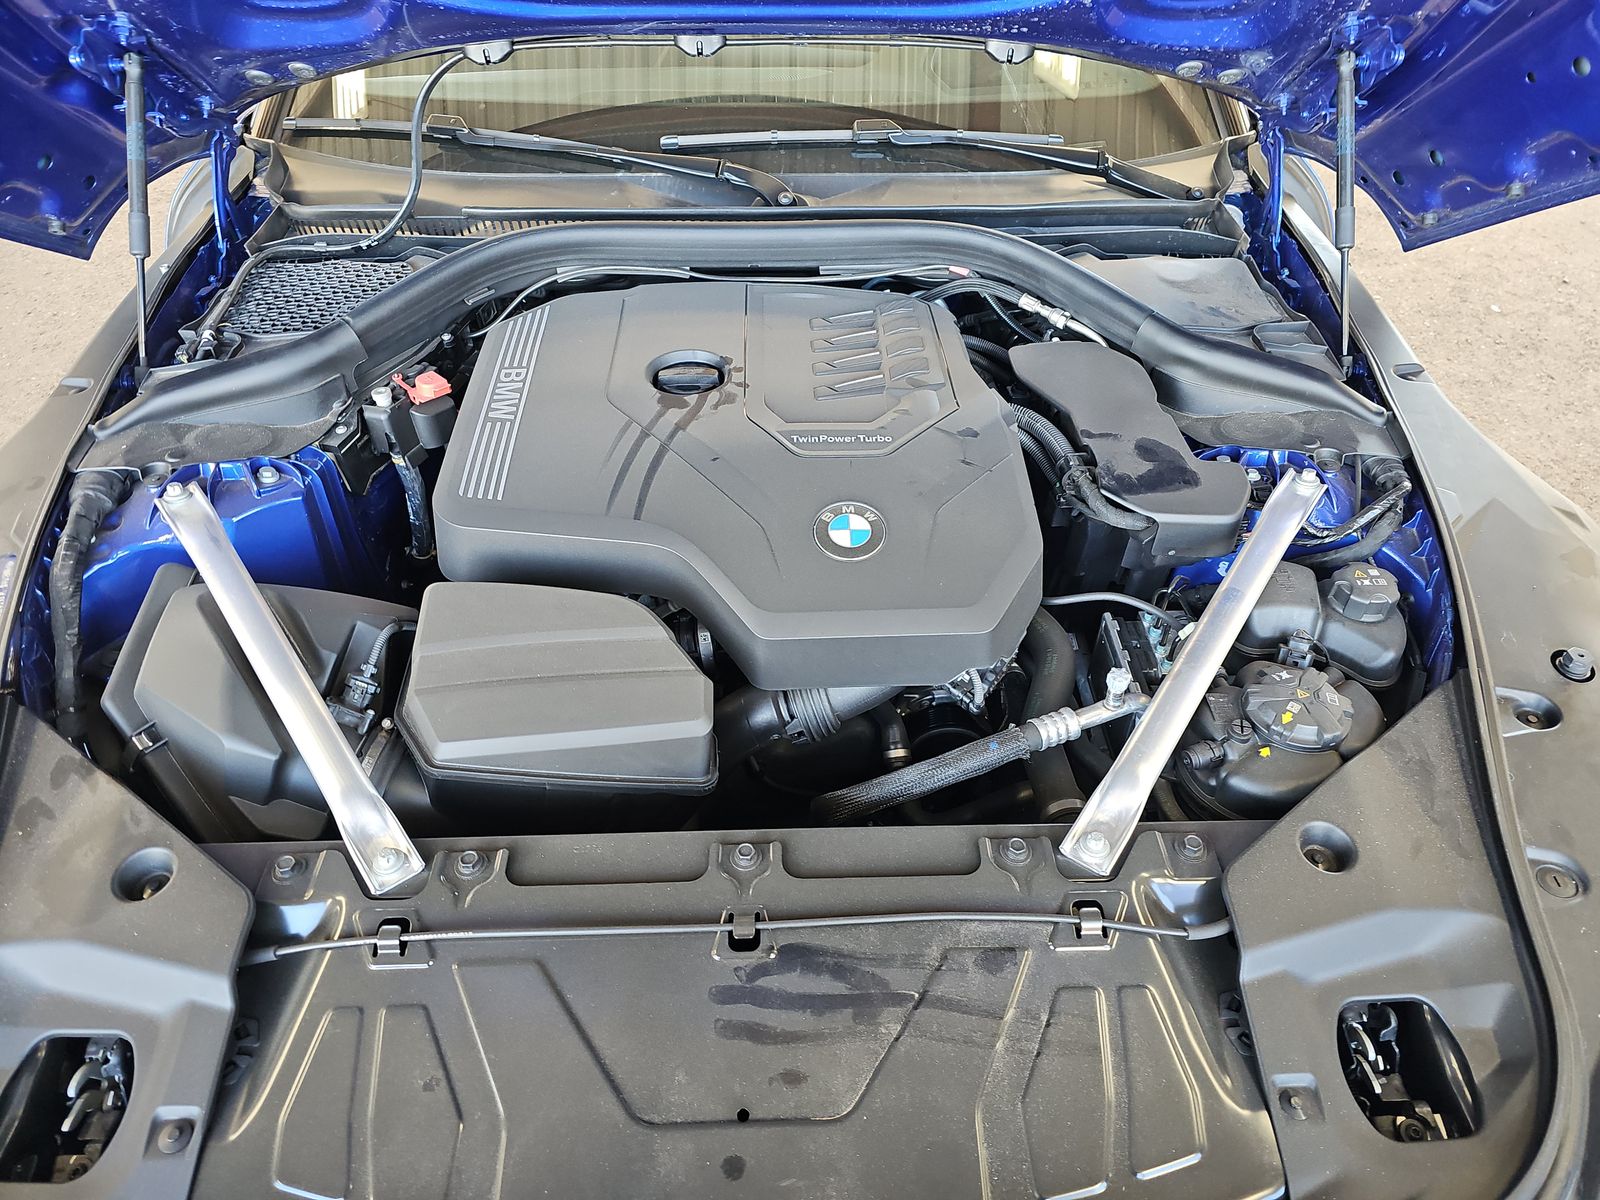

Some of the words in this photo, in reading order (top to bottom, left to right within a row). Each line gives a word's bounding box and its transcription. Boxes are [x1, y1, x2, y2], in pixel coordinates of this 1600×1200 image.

[488, 368, 527, 420] BMW
[790, 434, 857, 443] TwinPower
[857, 434, 893, 443] Turbo
[821, 504, 878, 522] BMW
